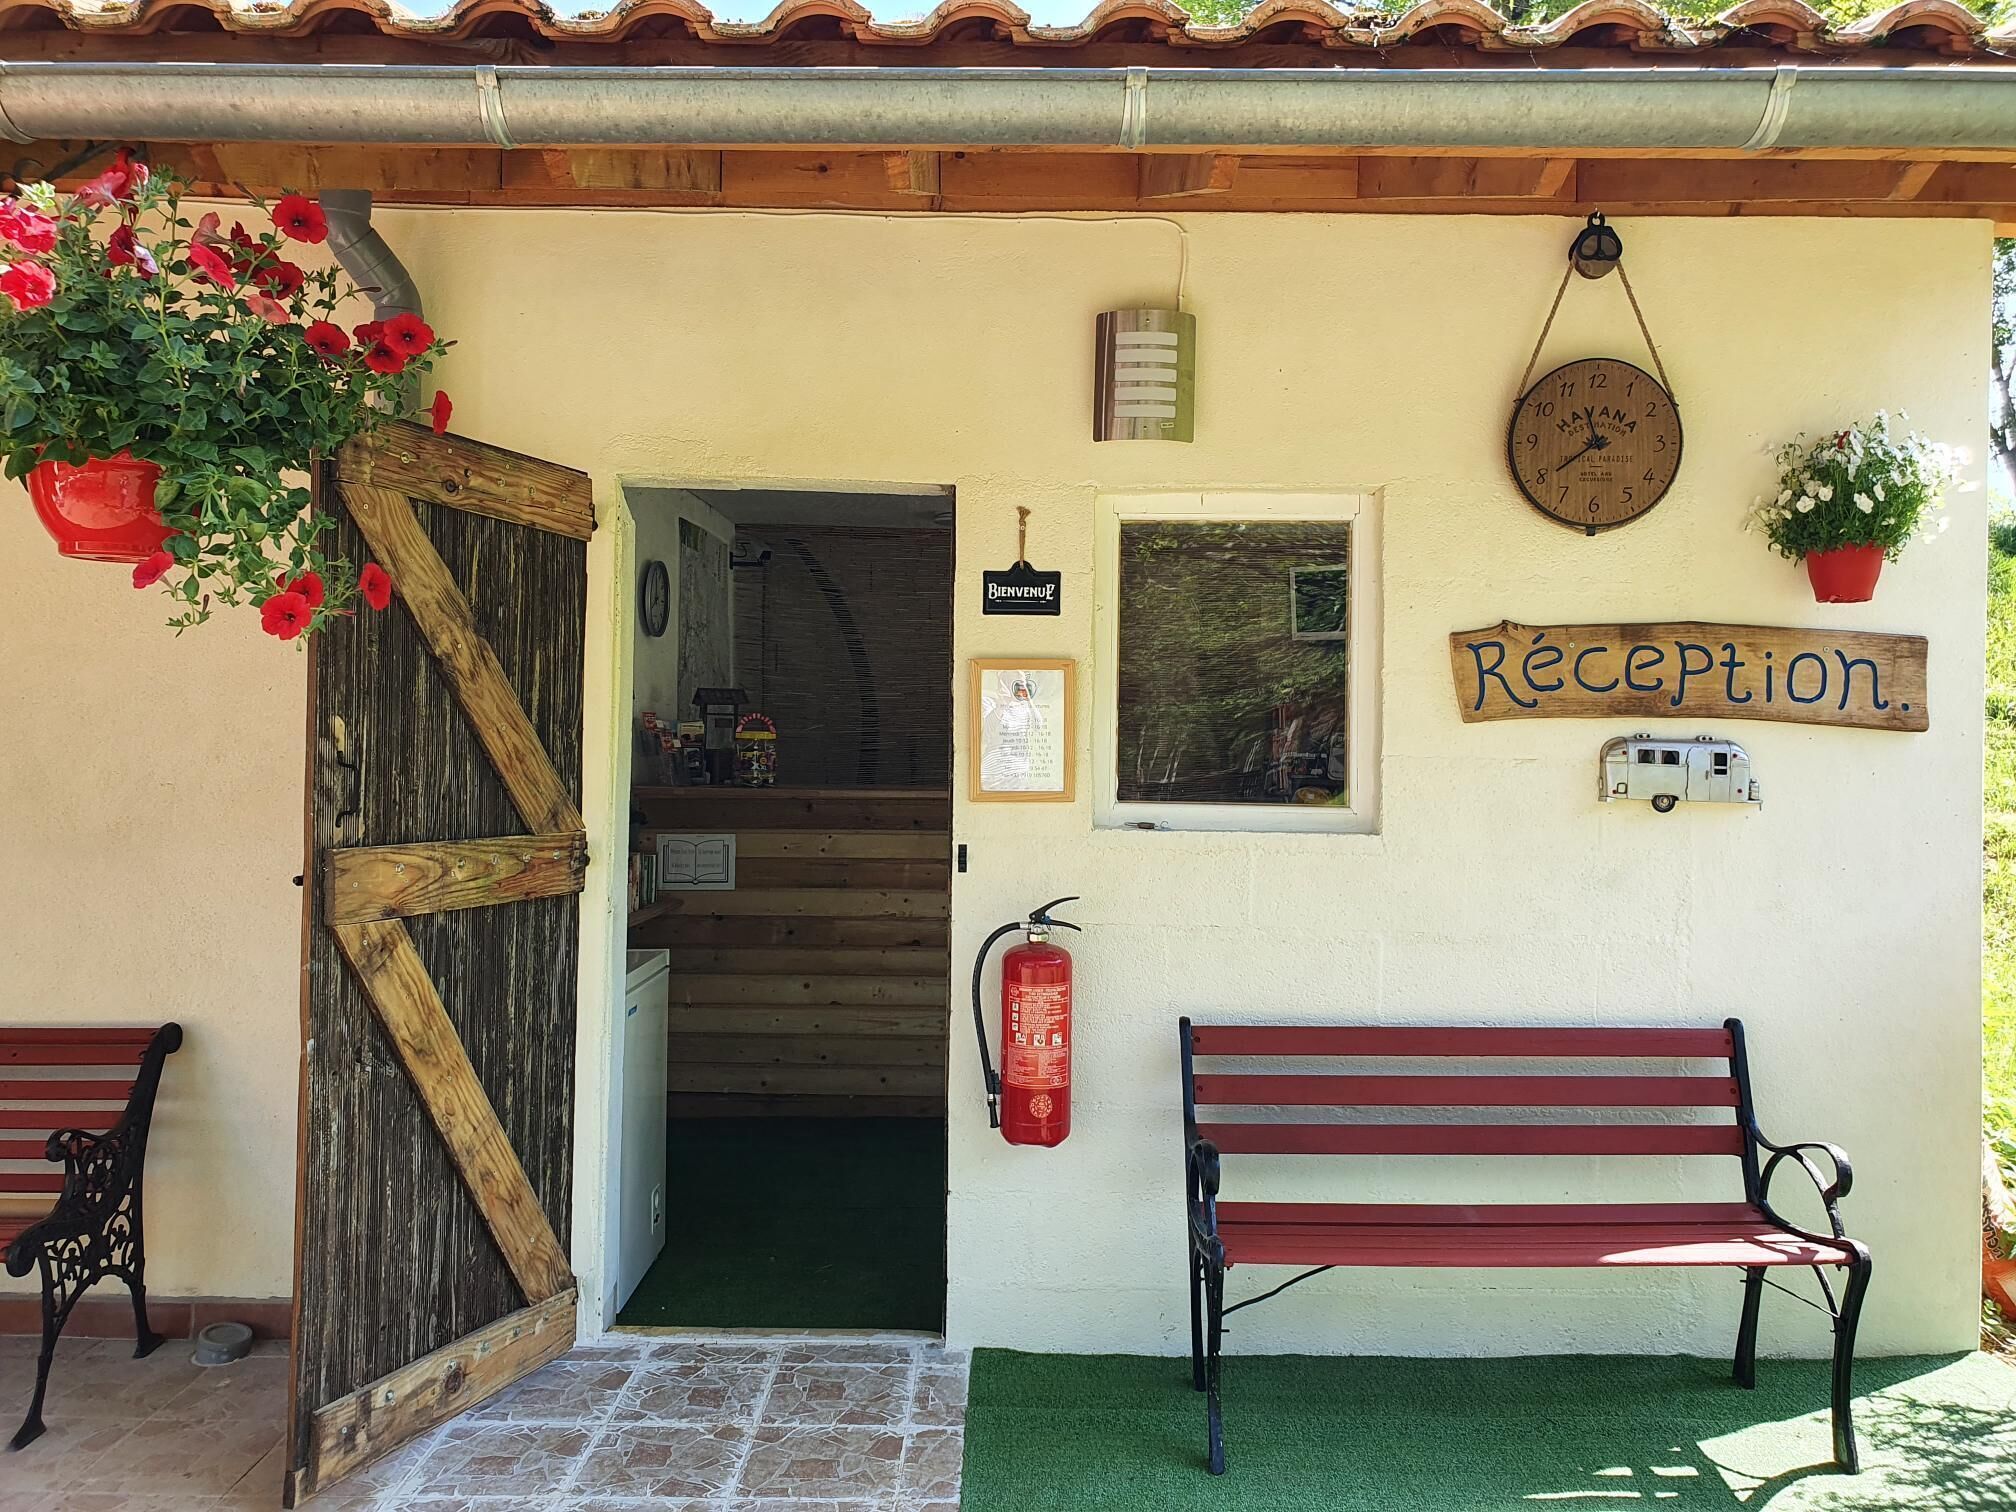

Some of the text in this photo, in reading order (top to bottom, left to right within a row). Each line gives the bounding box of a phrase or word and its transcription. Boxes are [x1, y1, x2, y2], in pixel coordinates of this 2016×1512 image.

[1560, 382, 1575, 397] 11
[1589, 373, 1608, 389] 12
[1625, 382, 1634, 397] 1
[1534, 401, 1554, 417] 10
[1645, 402, 1657, 417] 2
[1557, 406, 1637, 433] HAVANA
[1567, 420, 1628, 437] DESTNATION
[1527, 433, 1538, 451] 9
[1653, 435, 1666, 452] 3
[1598, 455, 1633, 463] PARADISE
[1536, 468, 1549, 485] 8
[1643, 468, 1655, 485] 4
[1559, 486, 1569, 503] 7
[1619, 486, 1633, 503] 5
[1588, 496, 1600, 513] 6
[988, 583, 1056, 600] BIENVENUE
[1465, 632, 1910, 711] Réception.
